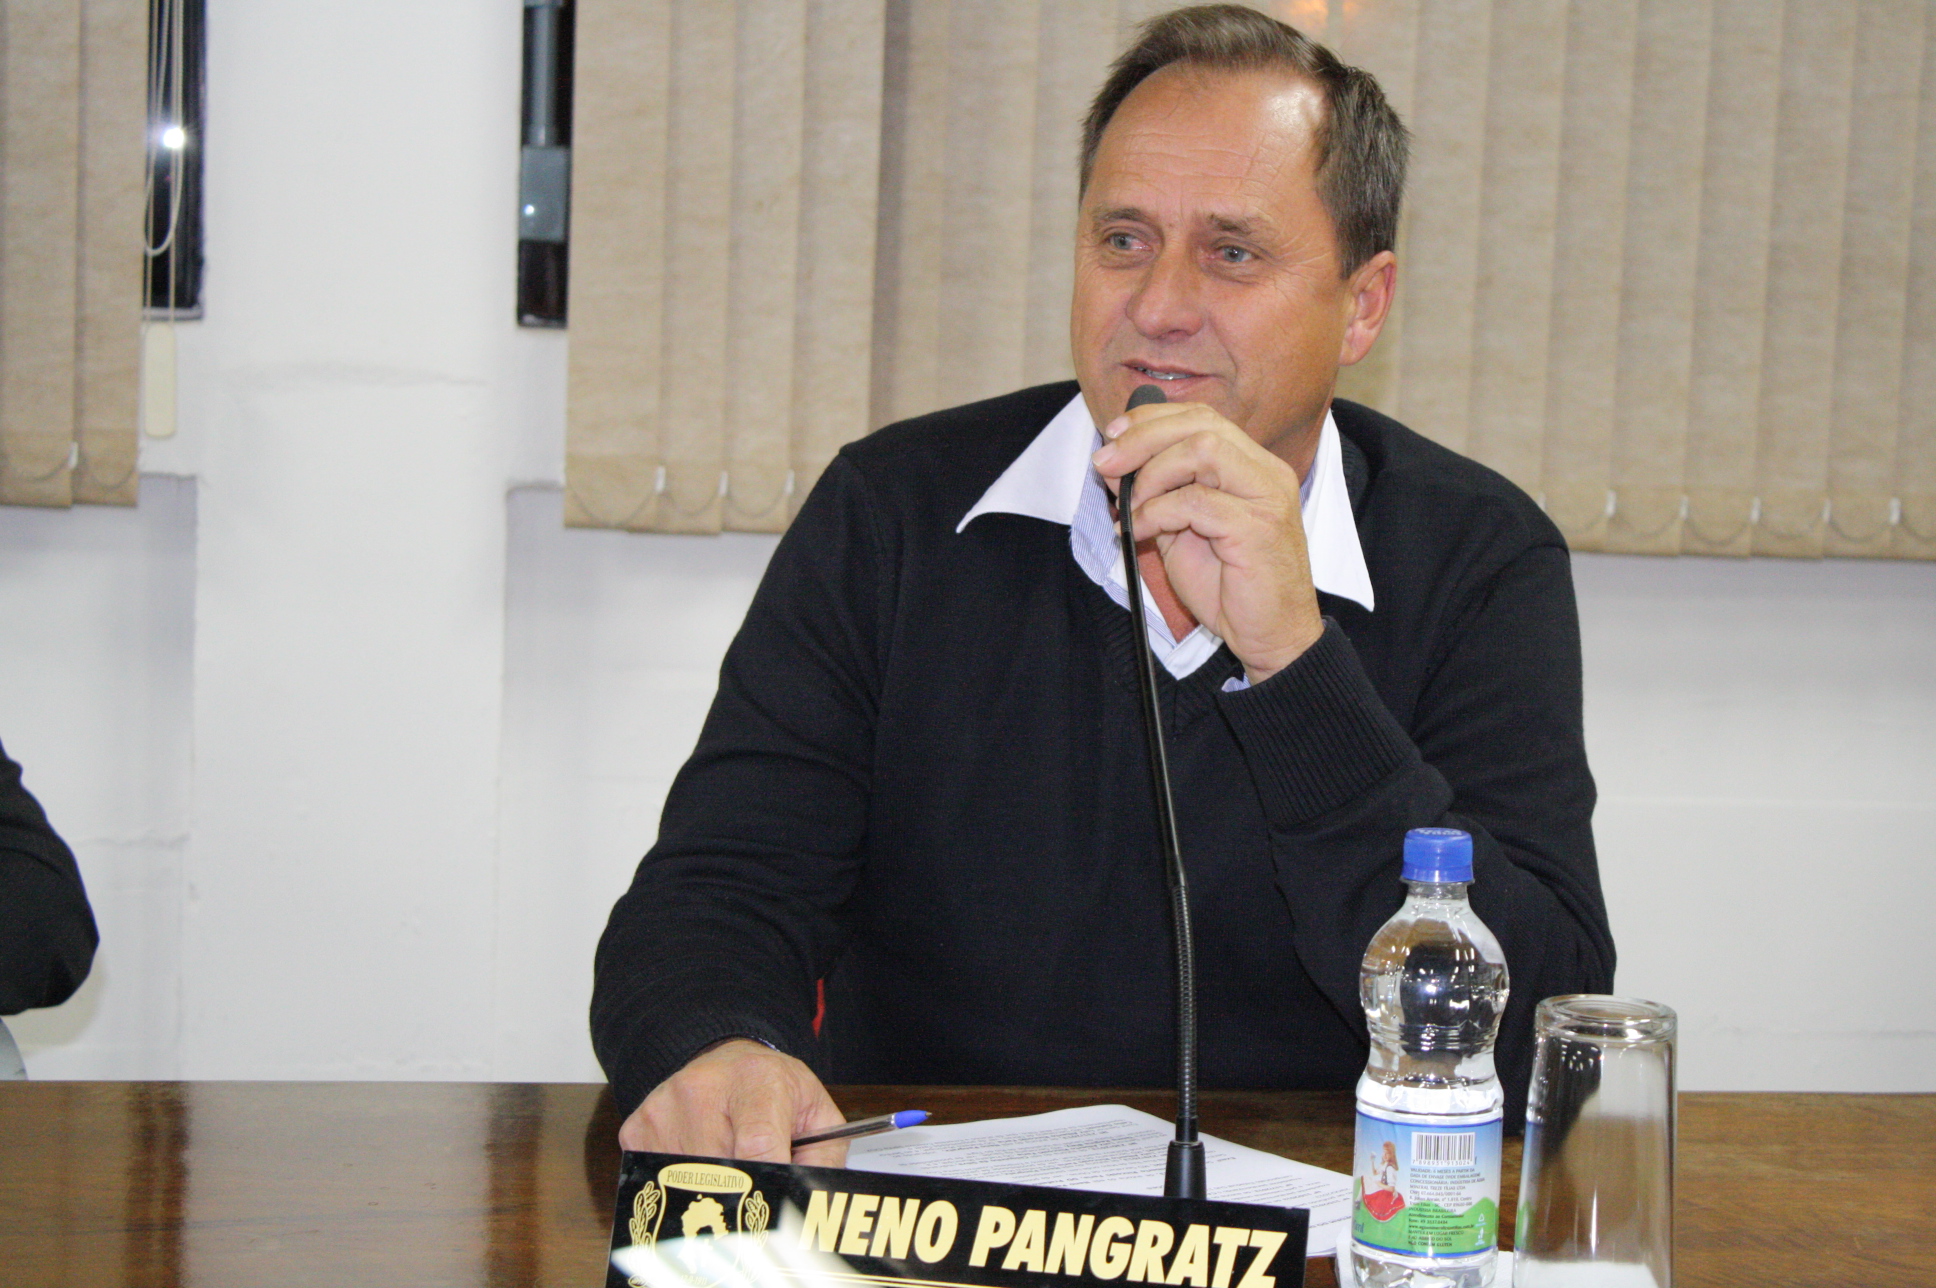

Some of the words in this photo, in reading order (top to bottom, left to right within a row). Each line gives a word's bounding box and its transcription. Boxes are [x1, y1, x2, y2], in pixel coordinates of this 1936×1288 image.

[667, 1170, 694, 1185] PODER
[695, 1172, 745, 1189] LEGISLATIVO
[798, 1190, 958, 1264] NENO
[968, 1205, 1288, 1288] PANGRATZ
